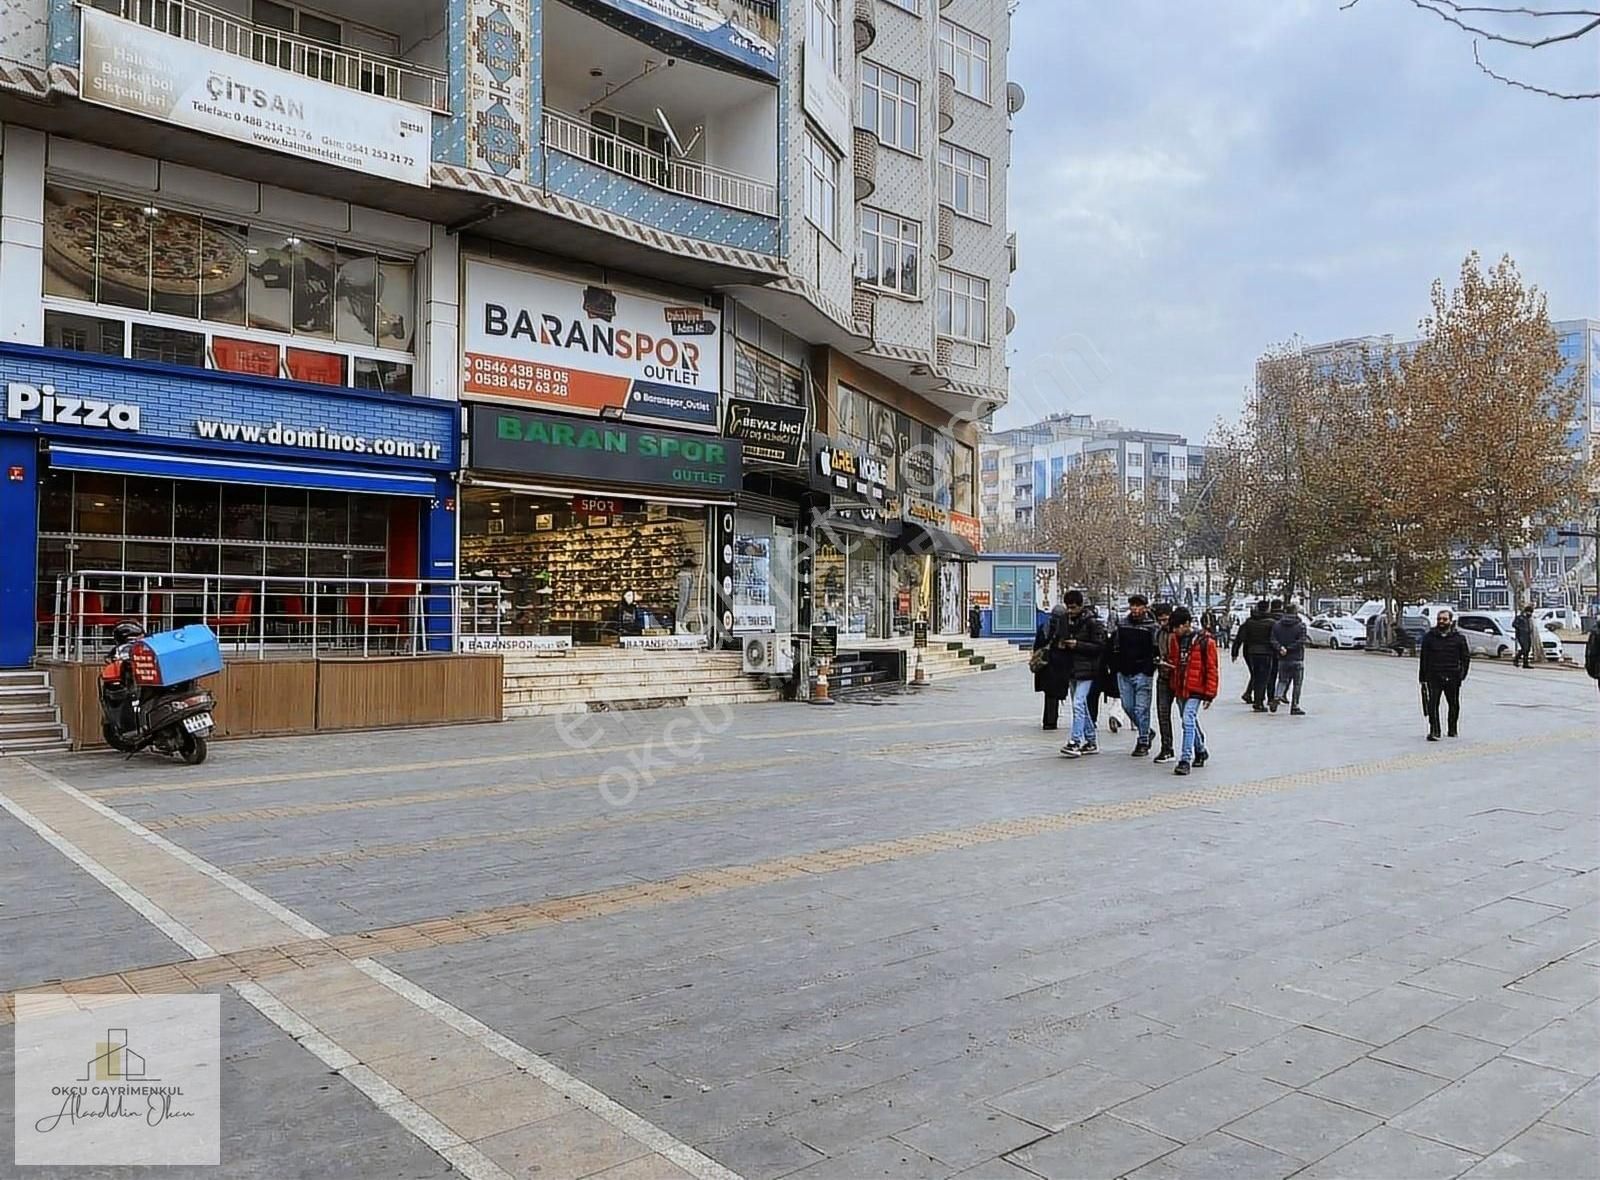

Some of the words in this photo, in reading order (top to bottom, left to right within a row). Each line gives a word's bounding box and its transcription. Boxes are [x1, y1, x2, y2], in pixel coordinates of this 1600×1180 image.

[206, 76, 304, 120] ÇİTSAN
[192, 100, 232, 120] Telefax:
[234, 112, 241, 121] 0
[403, 156, 415, 167] 72
[485, 302, 700, 372] BARANSPOR
[474, 373, 508, 387] 0538
[509, 378, 533, 391] 457
[535, 382, 551, 394] 63
[552, 384, 568, 397] 28
[475, 358, 508, 374] 0546
[509, 364, 533, 378] 438
[535, 368, 551, 381] 58
[553, 371, 569, 383] 05
[644, 365, 699, 385] OUTLET
[7, 382, 141, 431] Pizza
[198, 418, 441, 460] www.dominos.com.tr
[497, 414, 627, 453] BARAN
[637, 434, 726, 464] SPOR
[743, 417, 777, 431] BEYAZ
[779, 420, 801, 435] İNCİ
[672, 468, 725, 484] OUTLET
[581, 499, 614, 512] SPOR
